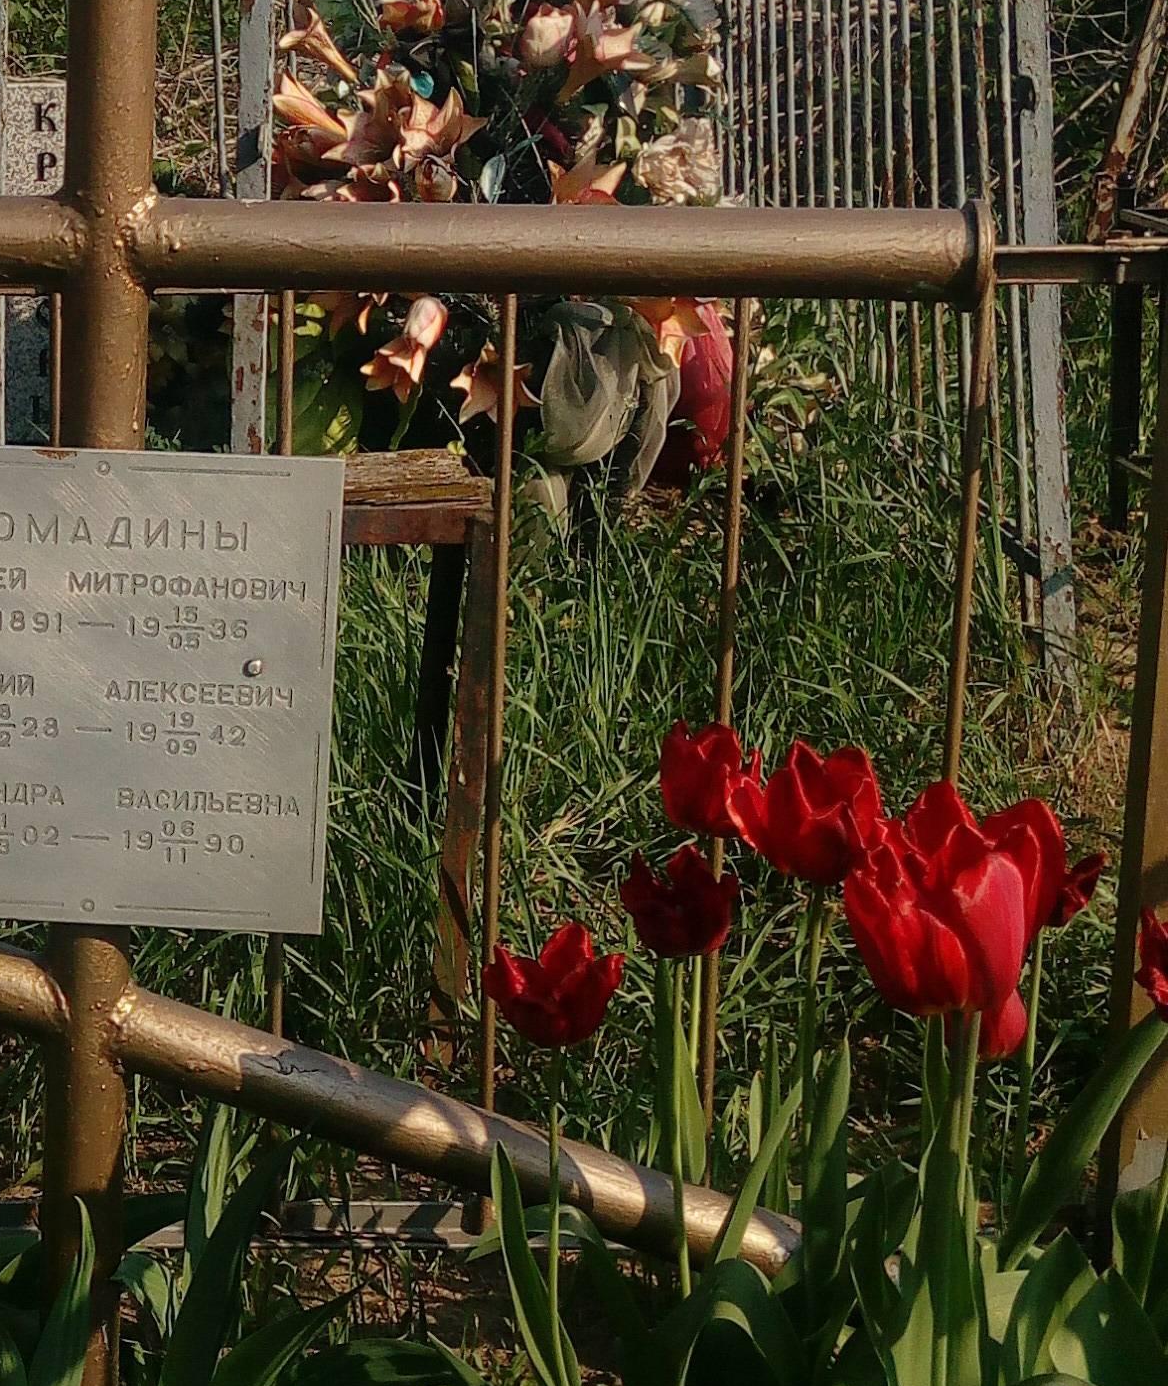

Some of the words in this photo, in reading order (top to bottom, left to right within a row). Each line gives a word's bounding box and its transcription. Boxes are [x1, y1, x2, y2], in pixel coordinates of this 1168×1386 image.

[67, 571, 307, 602] МИТРОФАНОВИЧ
[104, 679, 296, 709] АЛЕКСЕЕВИЧ
[116, 787, 300, 816] ВАСИЛЬЕВНА
